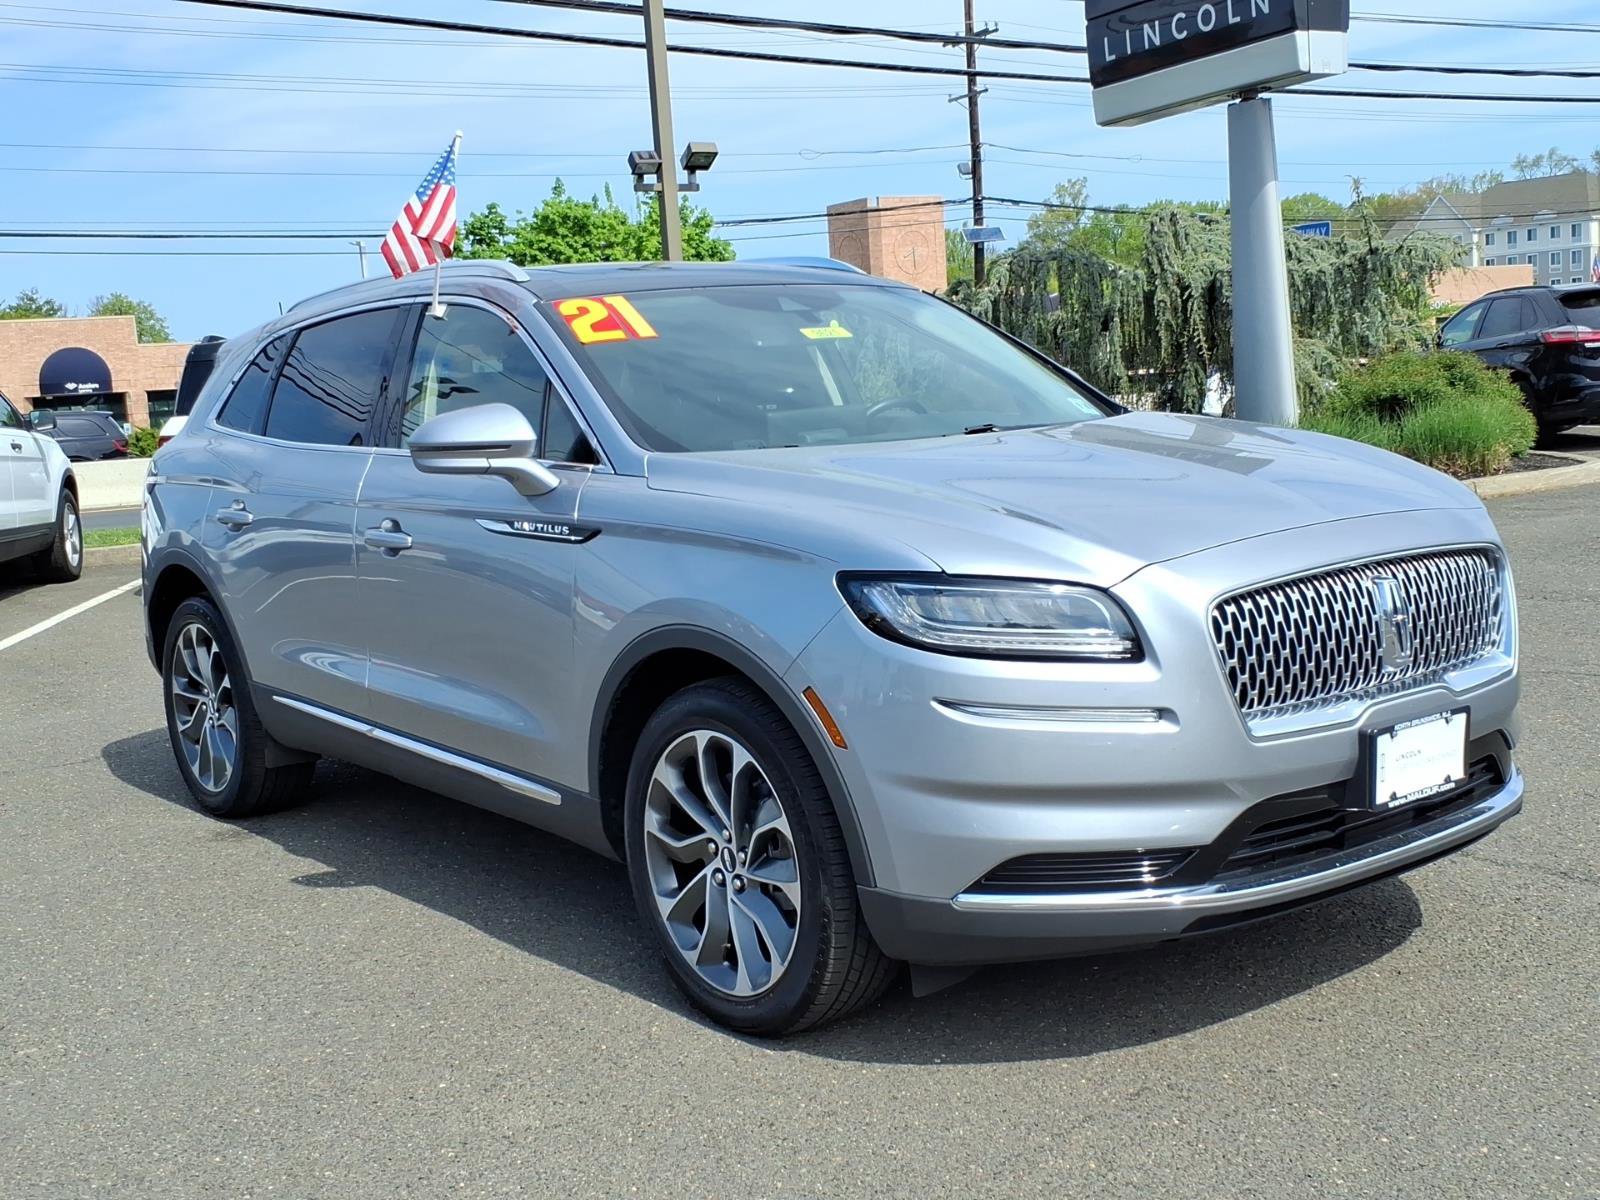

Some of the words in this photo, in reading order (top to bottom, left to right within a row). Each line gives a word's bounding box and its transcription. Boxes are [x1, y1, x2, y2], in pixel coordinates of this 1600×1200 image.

[1104, 0, 1270, 61] LINCOLN
[558, 295, 658, 344] 21
[514, 521, 570, 535] NAUTILUS
